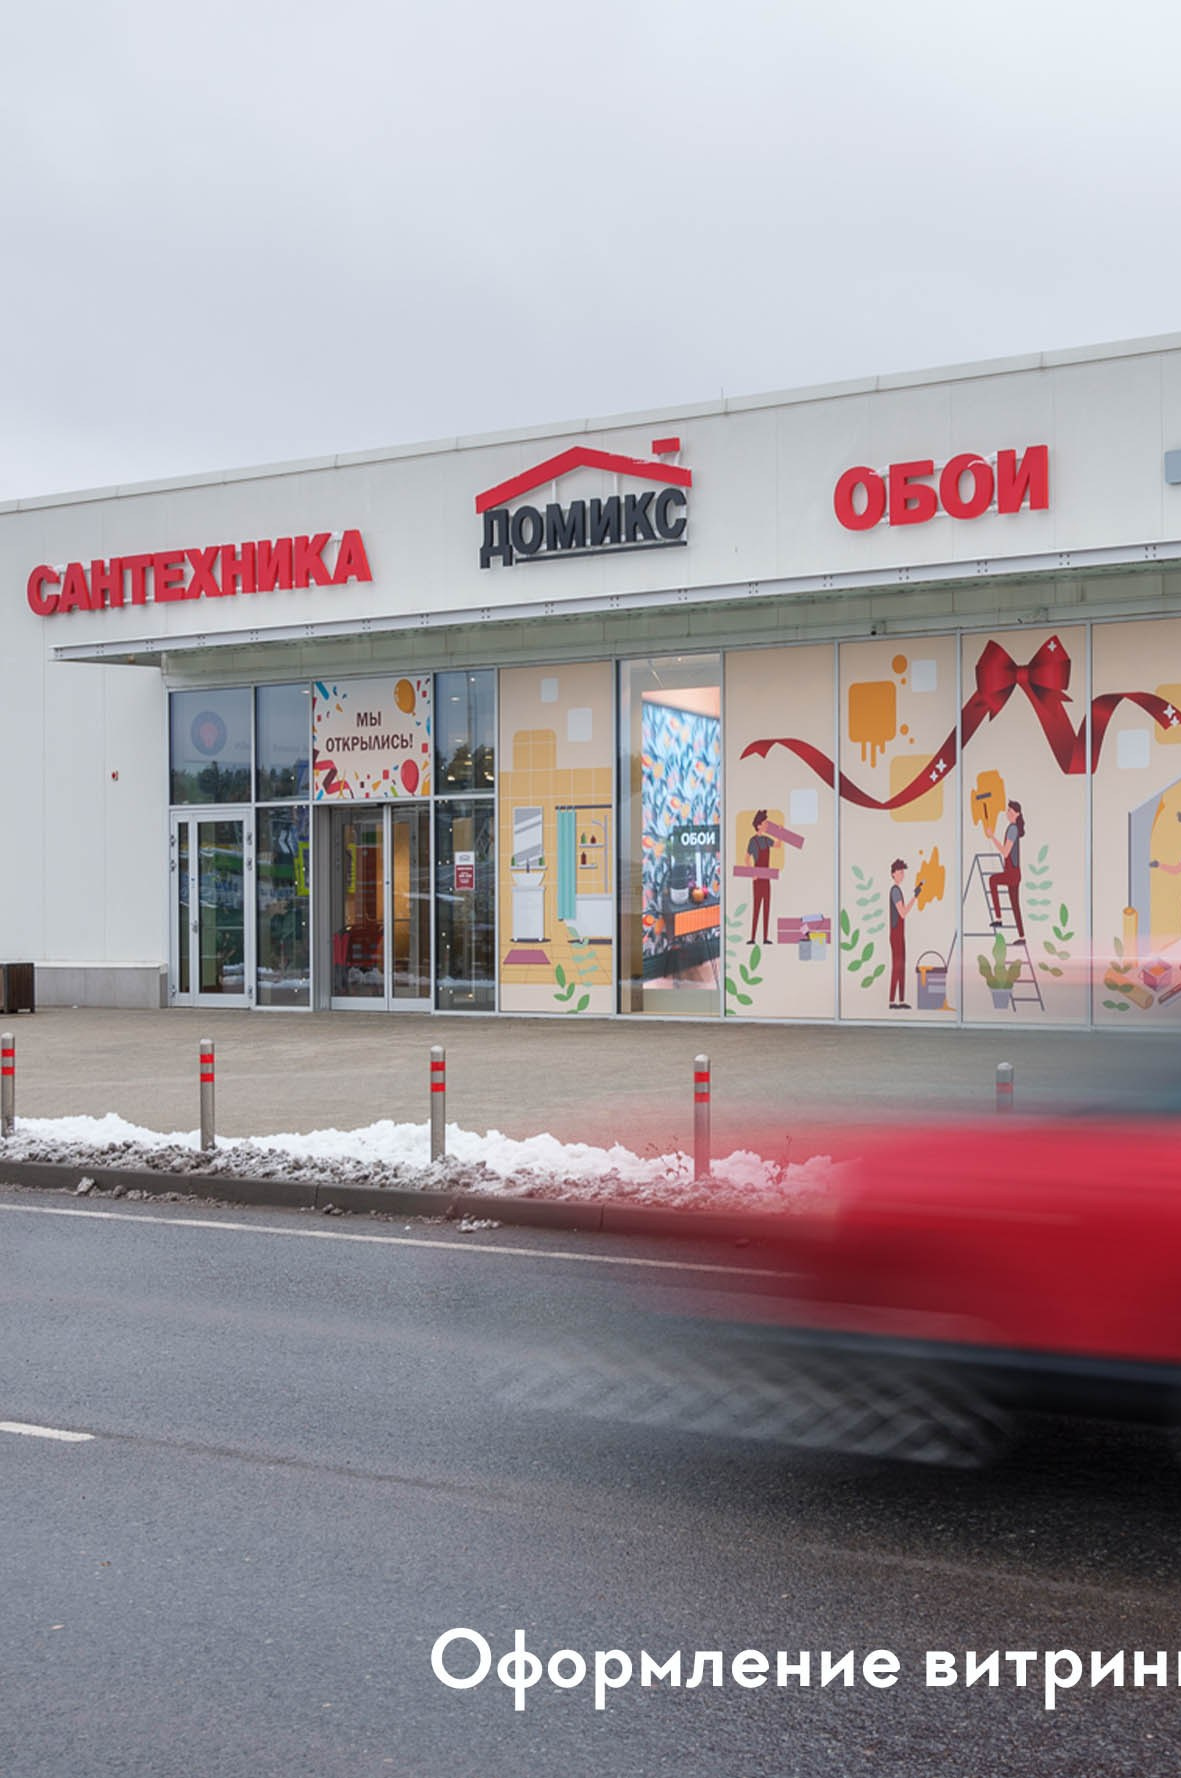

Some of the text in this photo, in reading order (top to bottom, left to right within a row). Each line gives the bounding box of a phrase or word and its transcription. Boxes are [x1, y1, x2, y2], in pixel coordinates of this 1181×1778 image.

[833, 444, 1049, 532] ОБОИ
[480, 488, 687, 569] ДОМИКС
[26, 529, 373, 616] САНТЕХНИКА
[325, 733, 413, 753] ОТКРЫЛИСЬ!
[356, 711, 382, 728] МЫ
[680, 831, 716, 846] ОБОИ
